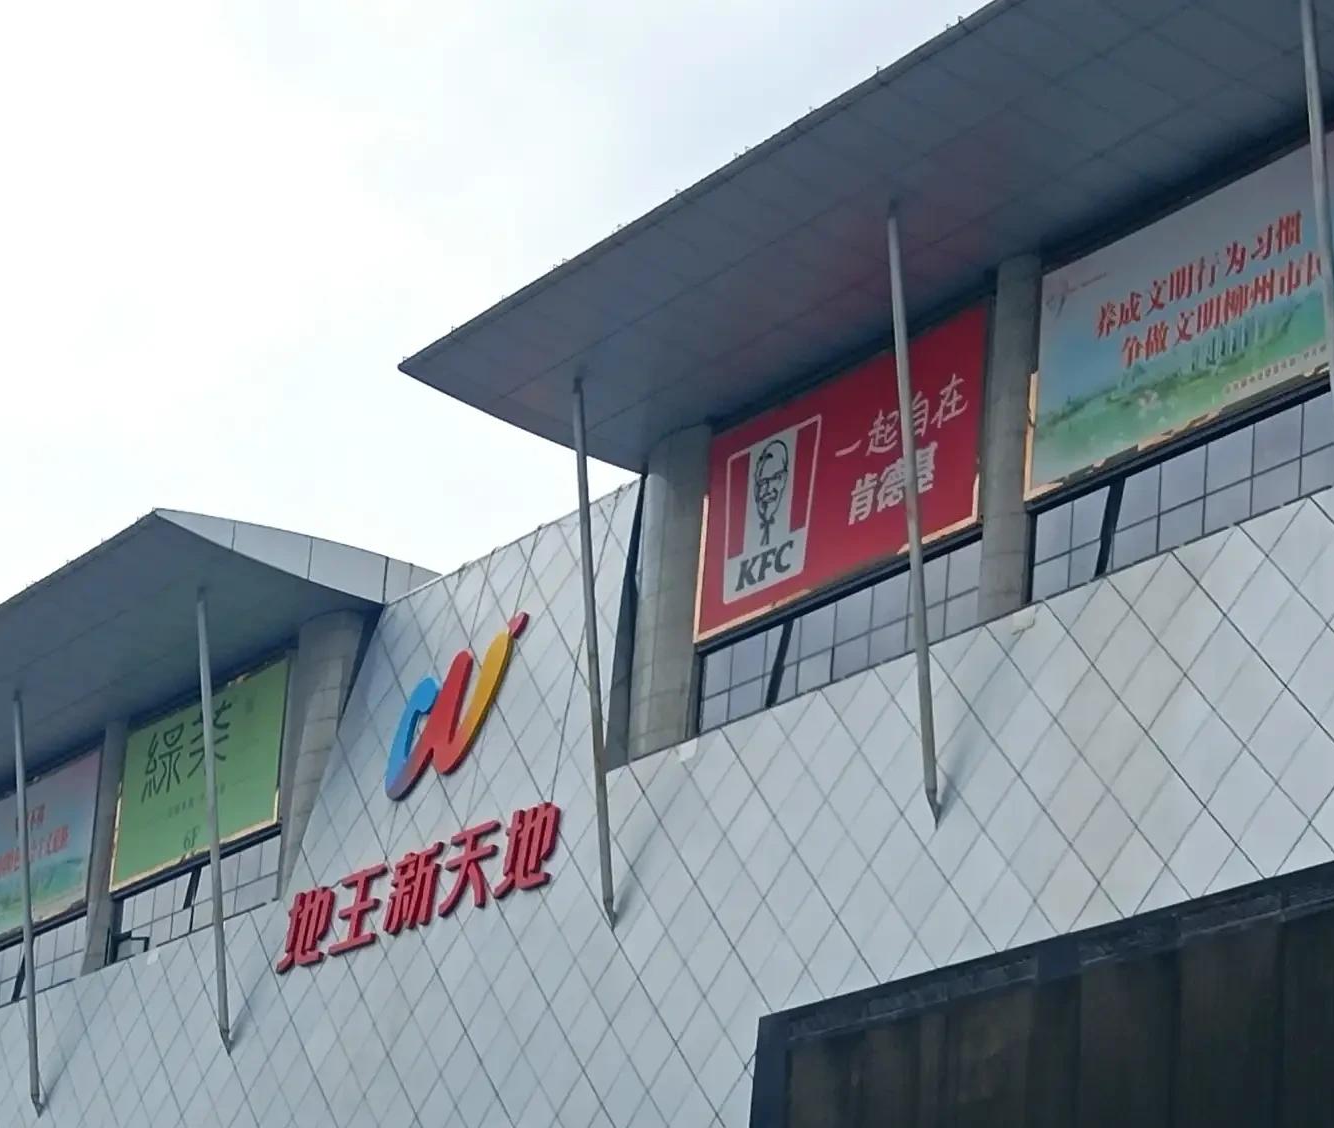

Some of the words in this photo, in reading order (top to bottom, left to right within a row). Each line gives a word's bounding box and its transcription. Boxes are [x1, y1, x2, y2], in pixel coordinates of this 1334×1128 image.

[1095, 210, 1303, 338] 养成文明行为习惯
[835, 373, 968, 457] 一起自在
[735, 540, 794, 592] KFC
[276, 801, 562, 976] 地王新天地
